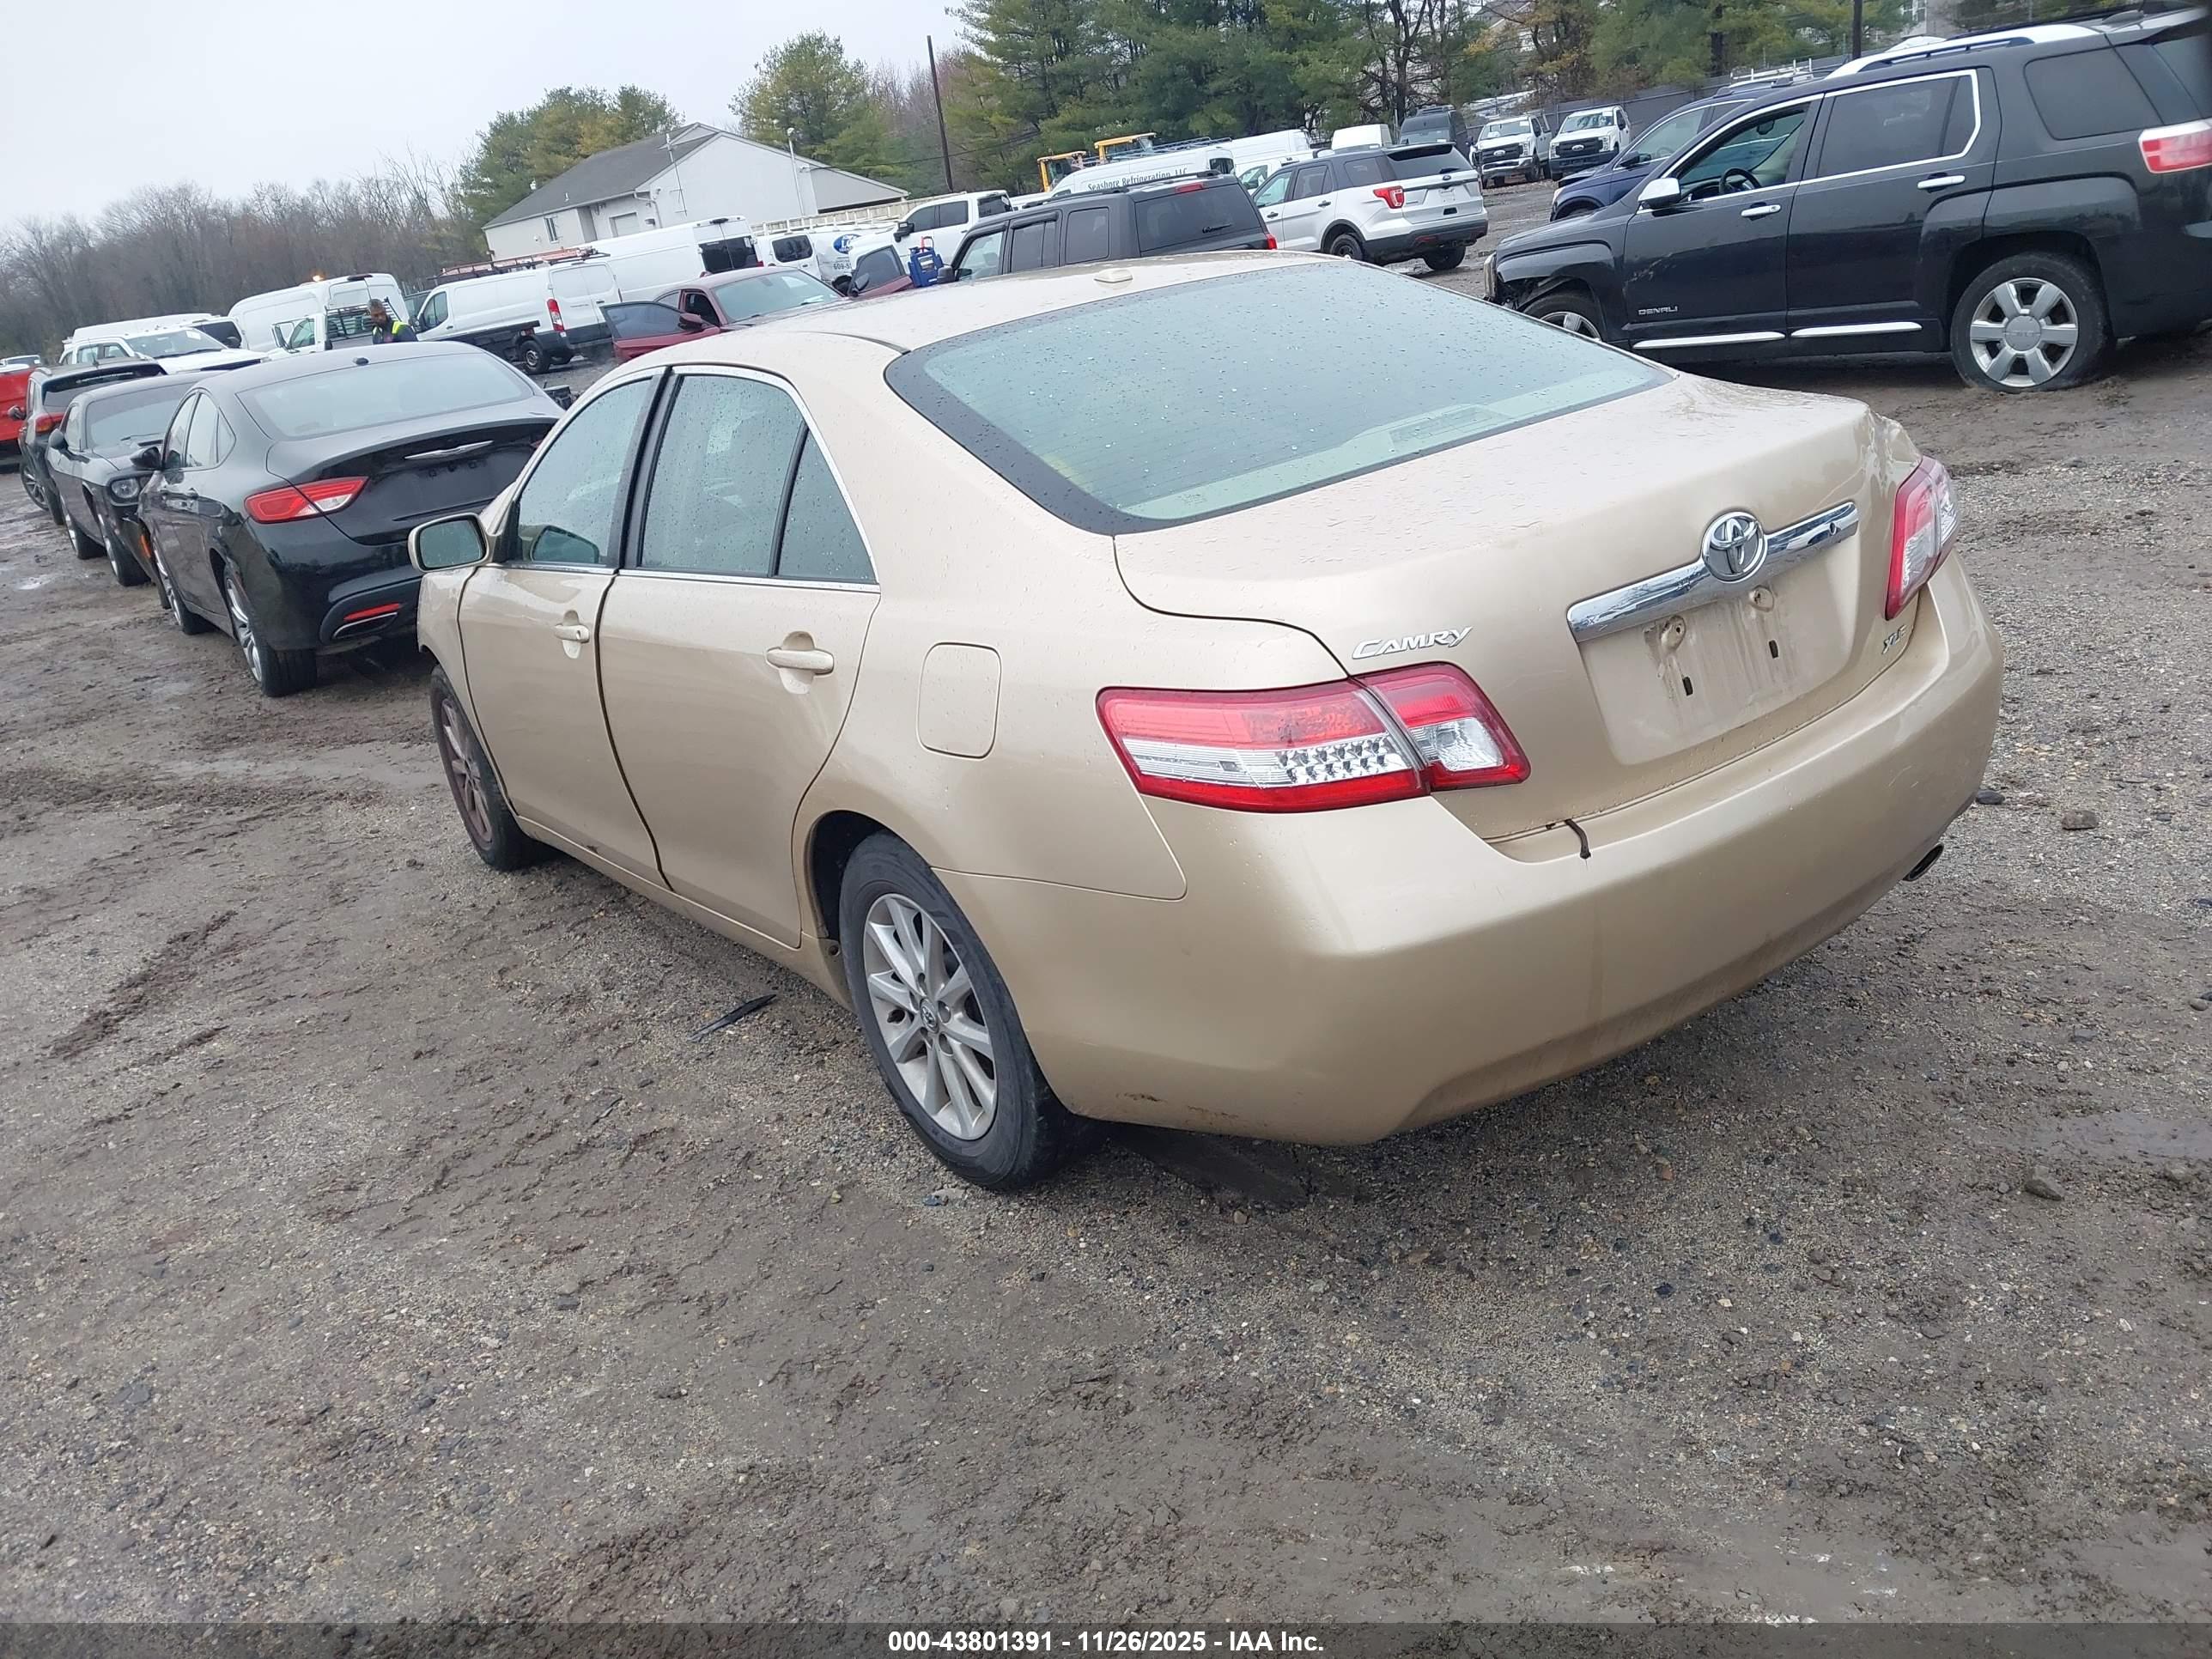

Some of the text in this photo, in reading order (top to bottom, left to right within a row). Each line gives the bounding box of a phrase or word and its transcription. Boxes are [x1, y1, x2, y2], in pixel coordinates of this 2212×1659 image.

[1087, 178, 1120, 191] Seashore
[1121, 171, 1171, 186] Refrigeration
[1638, 306, 1678, 315] DENALI
[1881, 624, 1906, 654] XLE
